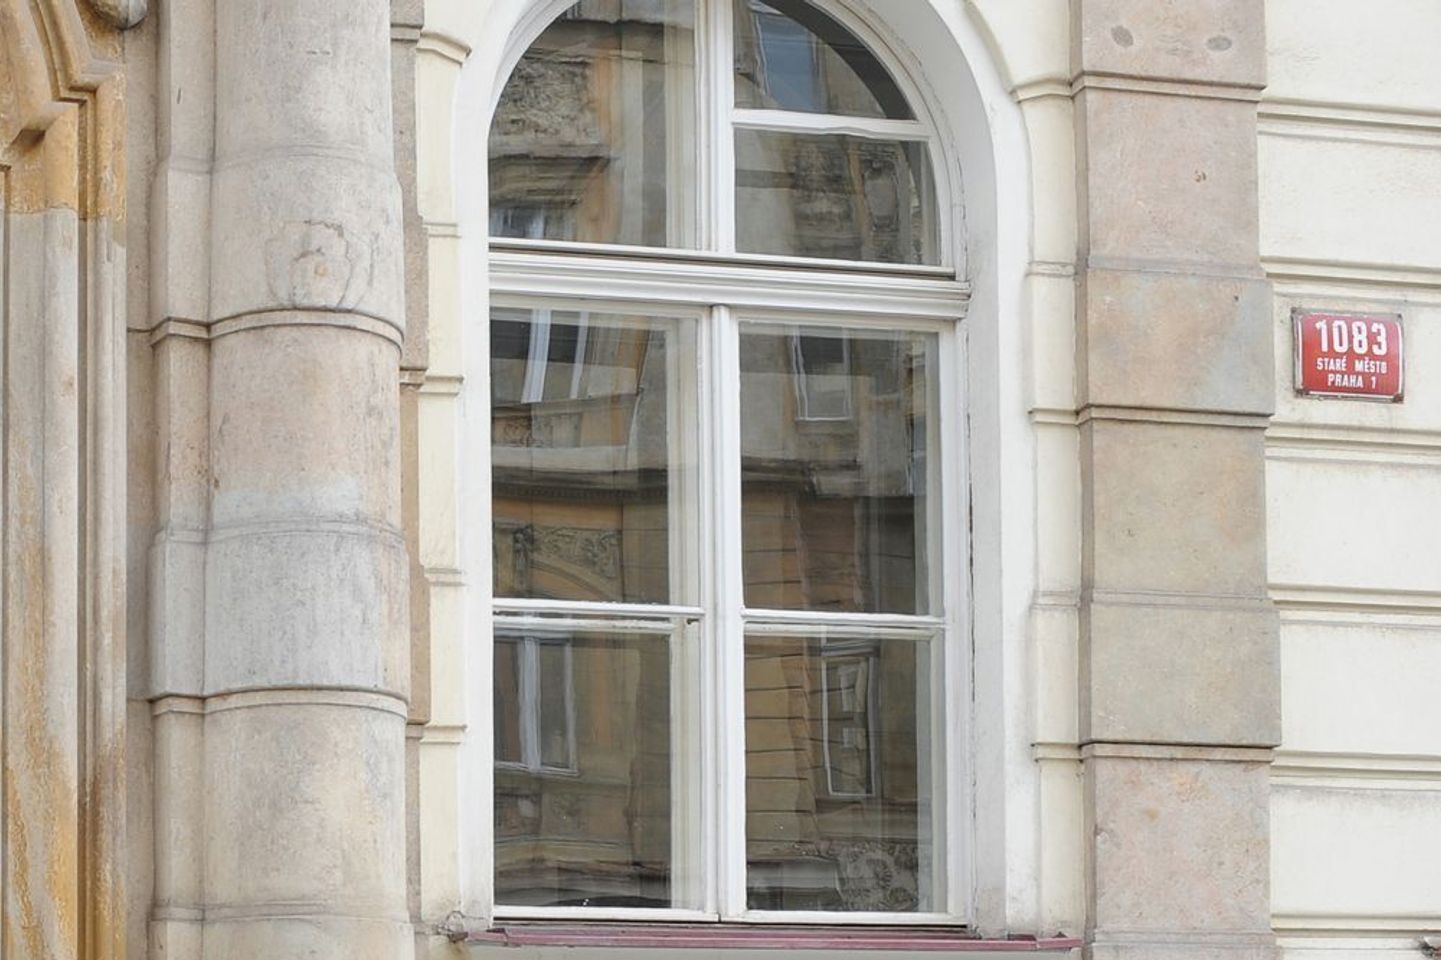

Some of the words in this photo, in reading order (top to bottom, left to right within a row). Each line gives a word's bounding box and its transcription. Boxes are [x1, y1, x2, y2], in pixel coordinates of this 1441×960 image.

[1315, 320, 1387, 356] 1083
[1316, 356, 1347, 371] STARÉ
[1354, 357, 1387, 374] MĚSTO
[1327, 374, 1364, 388] PRAHA
[1371, 376, 1376, 388] 1
